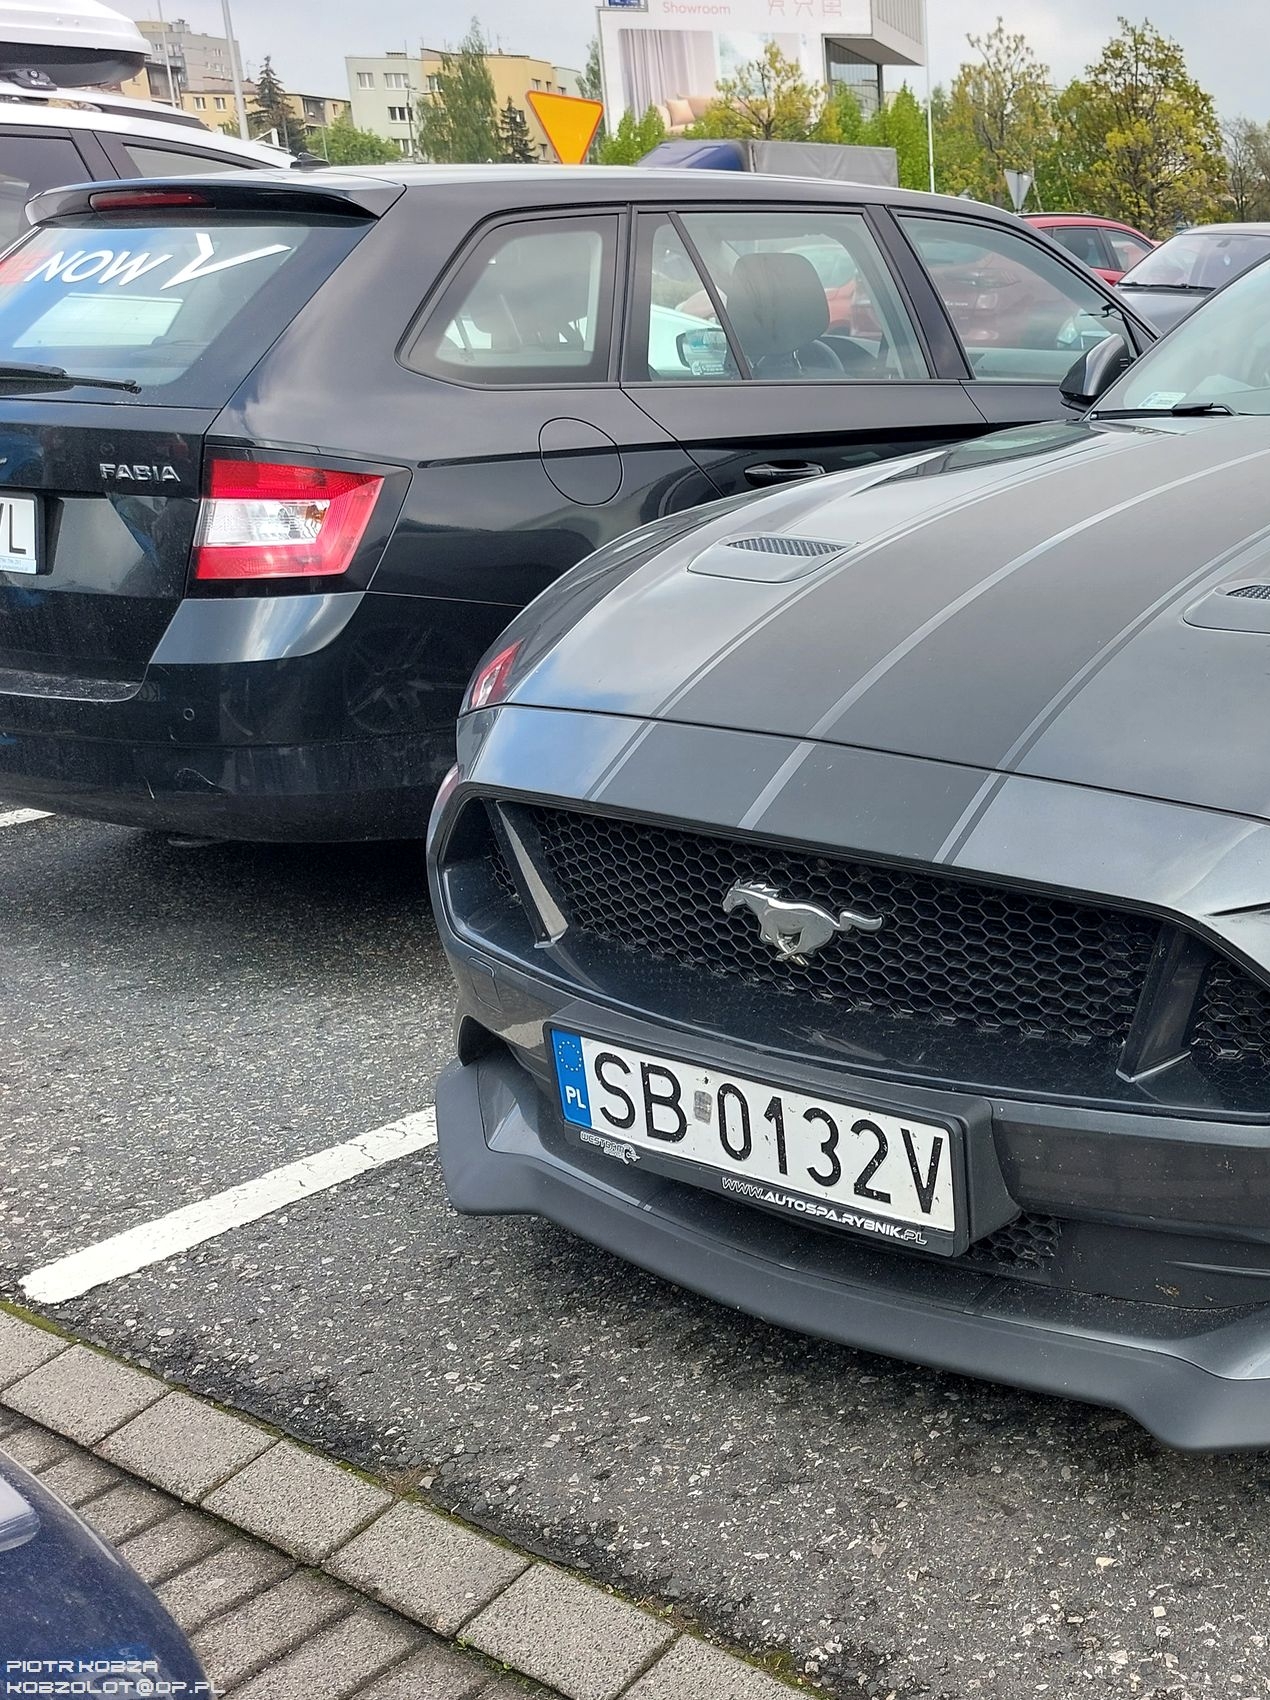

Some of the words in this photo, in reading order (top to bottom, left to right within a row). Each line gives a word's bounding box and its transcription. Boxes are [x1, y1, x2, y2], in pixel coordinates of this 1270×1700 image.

[663, 2, 731, 16] Showroom
[24, 250, 174, 286] NOW
[99, 463, 181, 482] FABIA
[565, 1085, 587, 1110] PL
[594, 1051, 688, 1143] SB
[717, 1082, 944, 1214] 0132V
